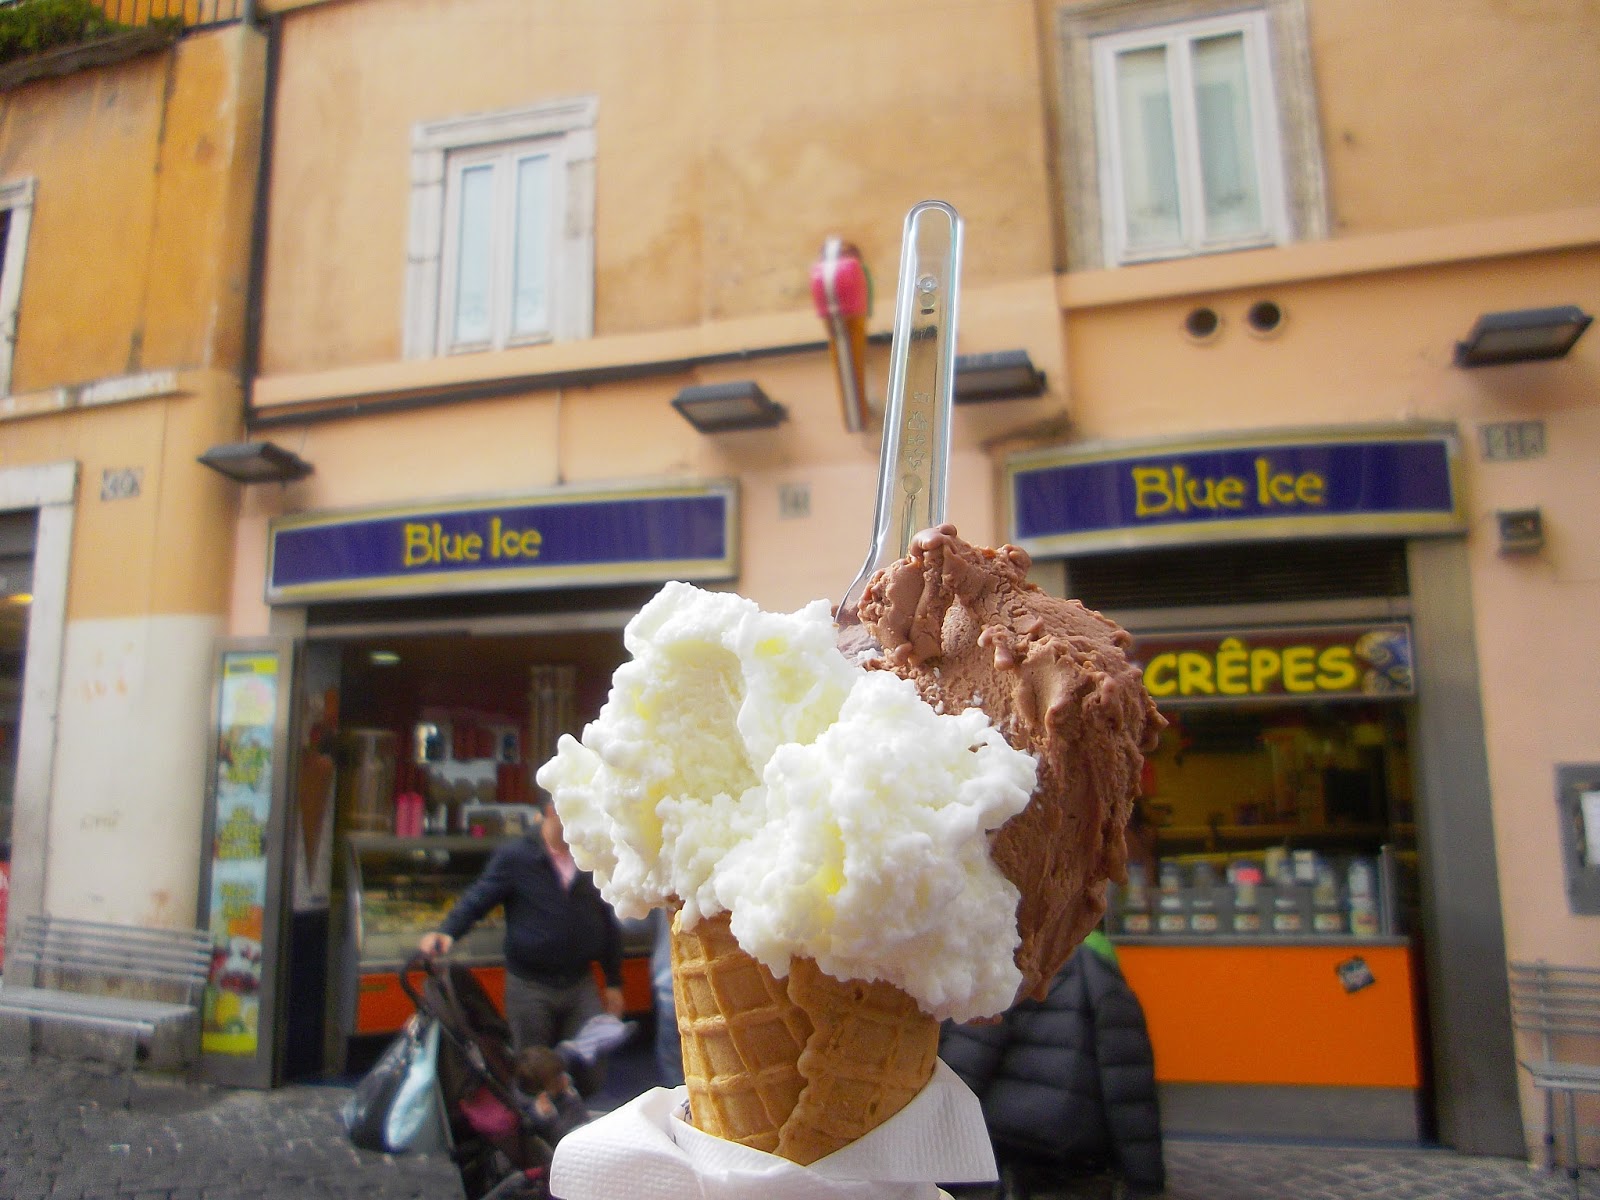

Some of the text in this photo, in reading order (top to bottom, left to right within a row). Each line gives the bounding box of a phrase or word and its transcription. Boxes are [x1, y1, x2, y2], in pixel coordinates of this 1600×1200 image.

[1131, 458, 1325, 517] Blue Ice
[403, 517, 542, 566] Blue Ice
[1143, 636, 1357, 696] CRÊPES
